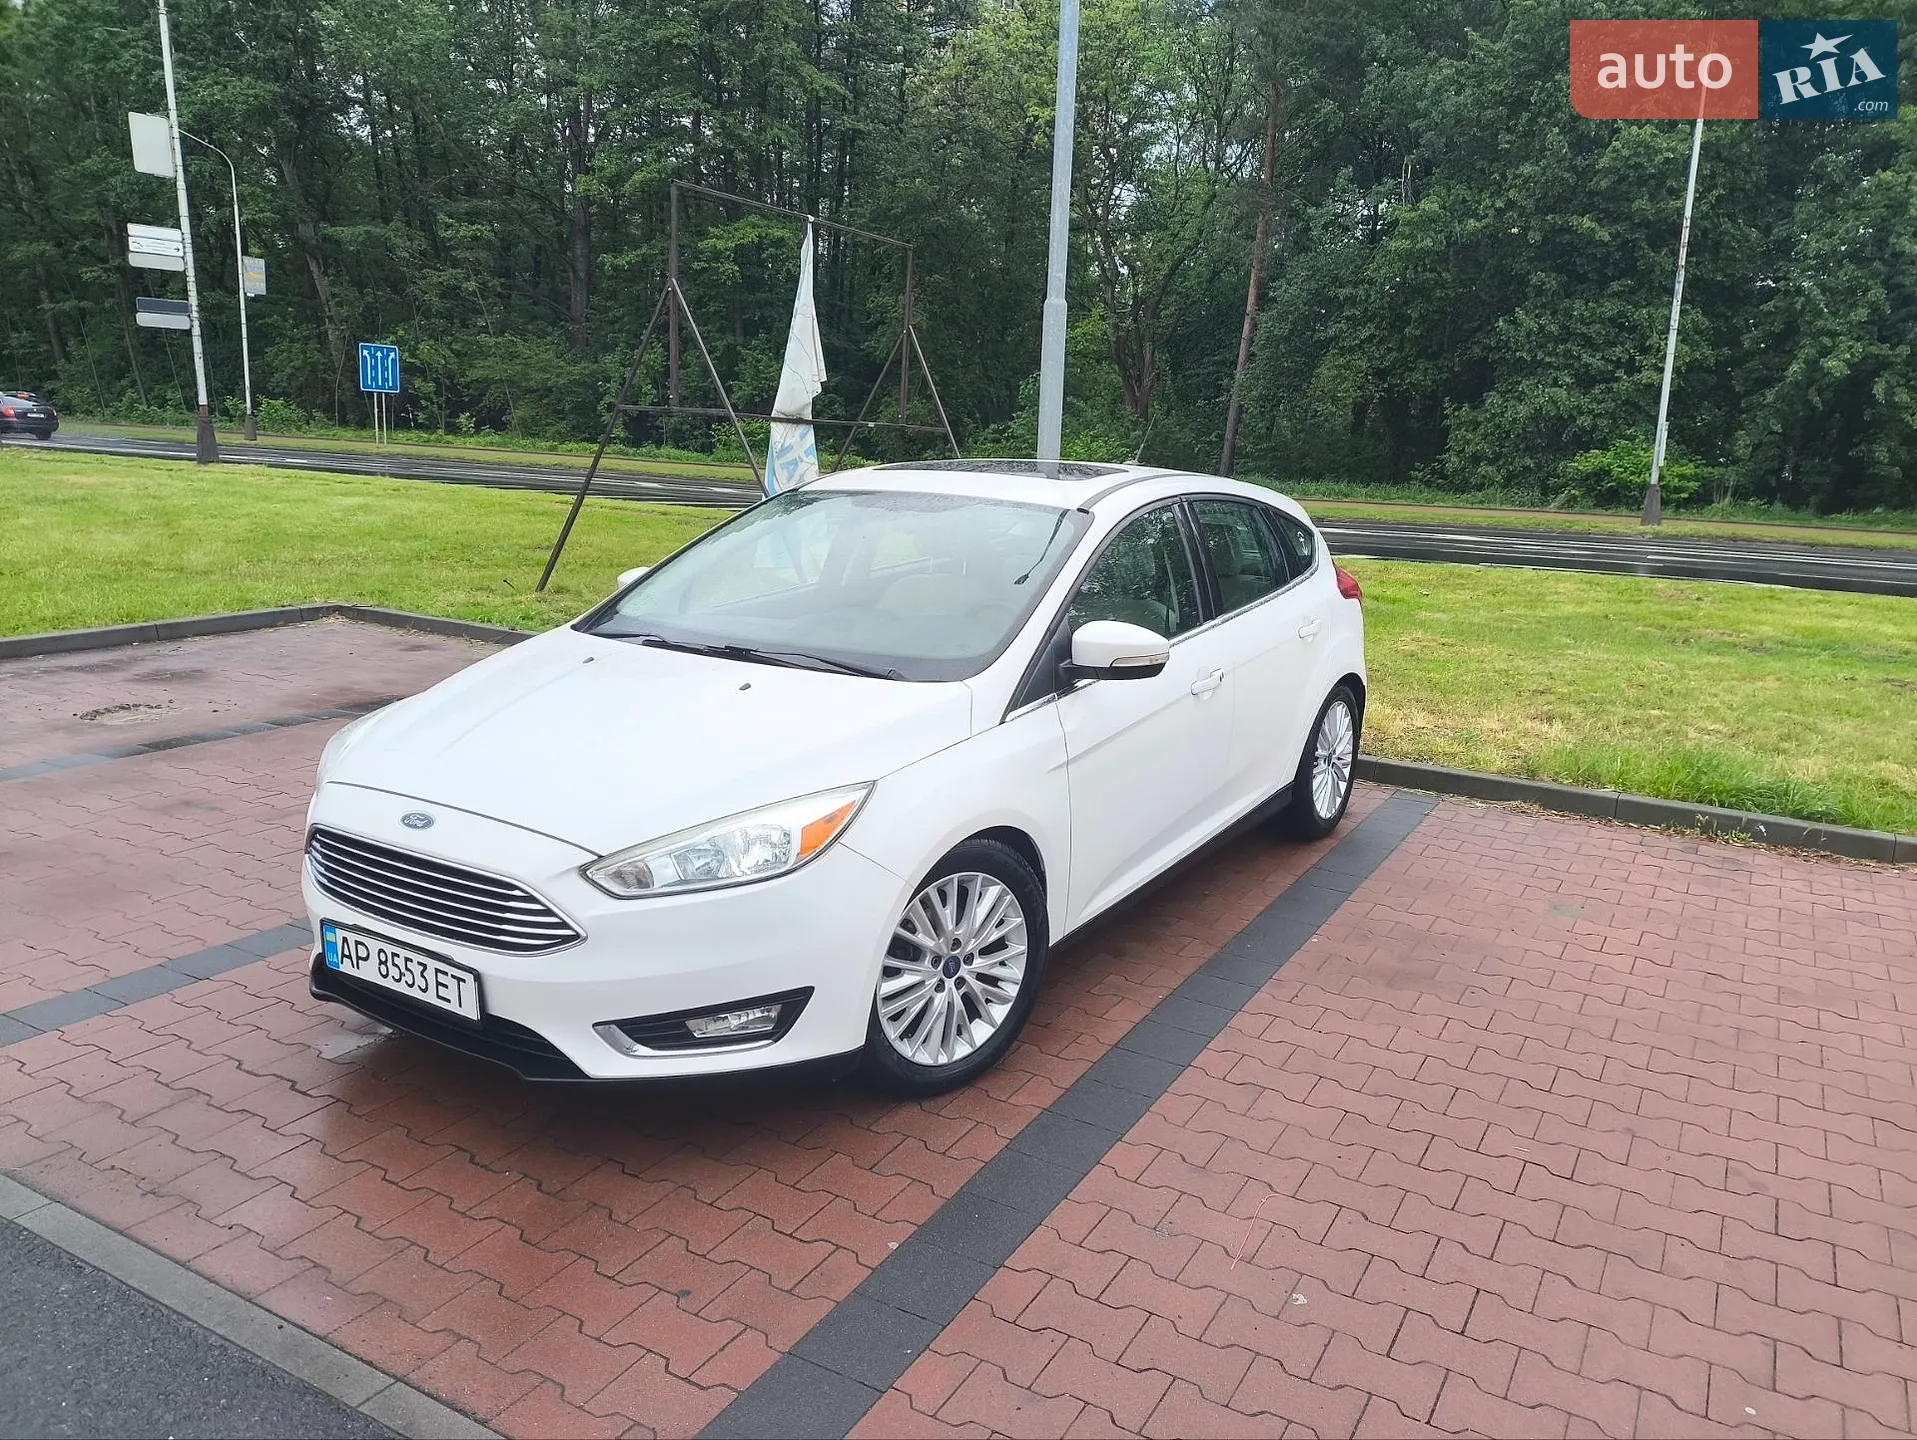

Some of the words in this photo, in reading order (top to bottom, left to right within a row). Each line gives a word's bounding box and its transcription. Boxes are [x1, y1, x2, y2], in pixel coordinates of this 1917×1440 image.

[328, 953, 339, 963] UA
[340, 936, 370, 970] AP
[377, 948, 428, 993] 8553
[434, 967, 466, 1008] ET
